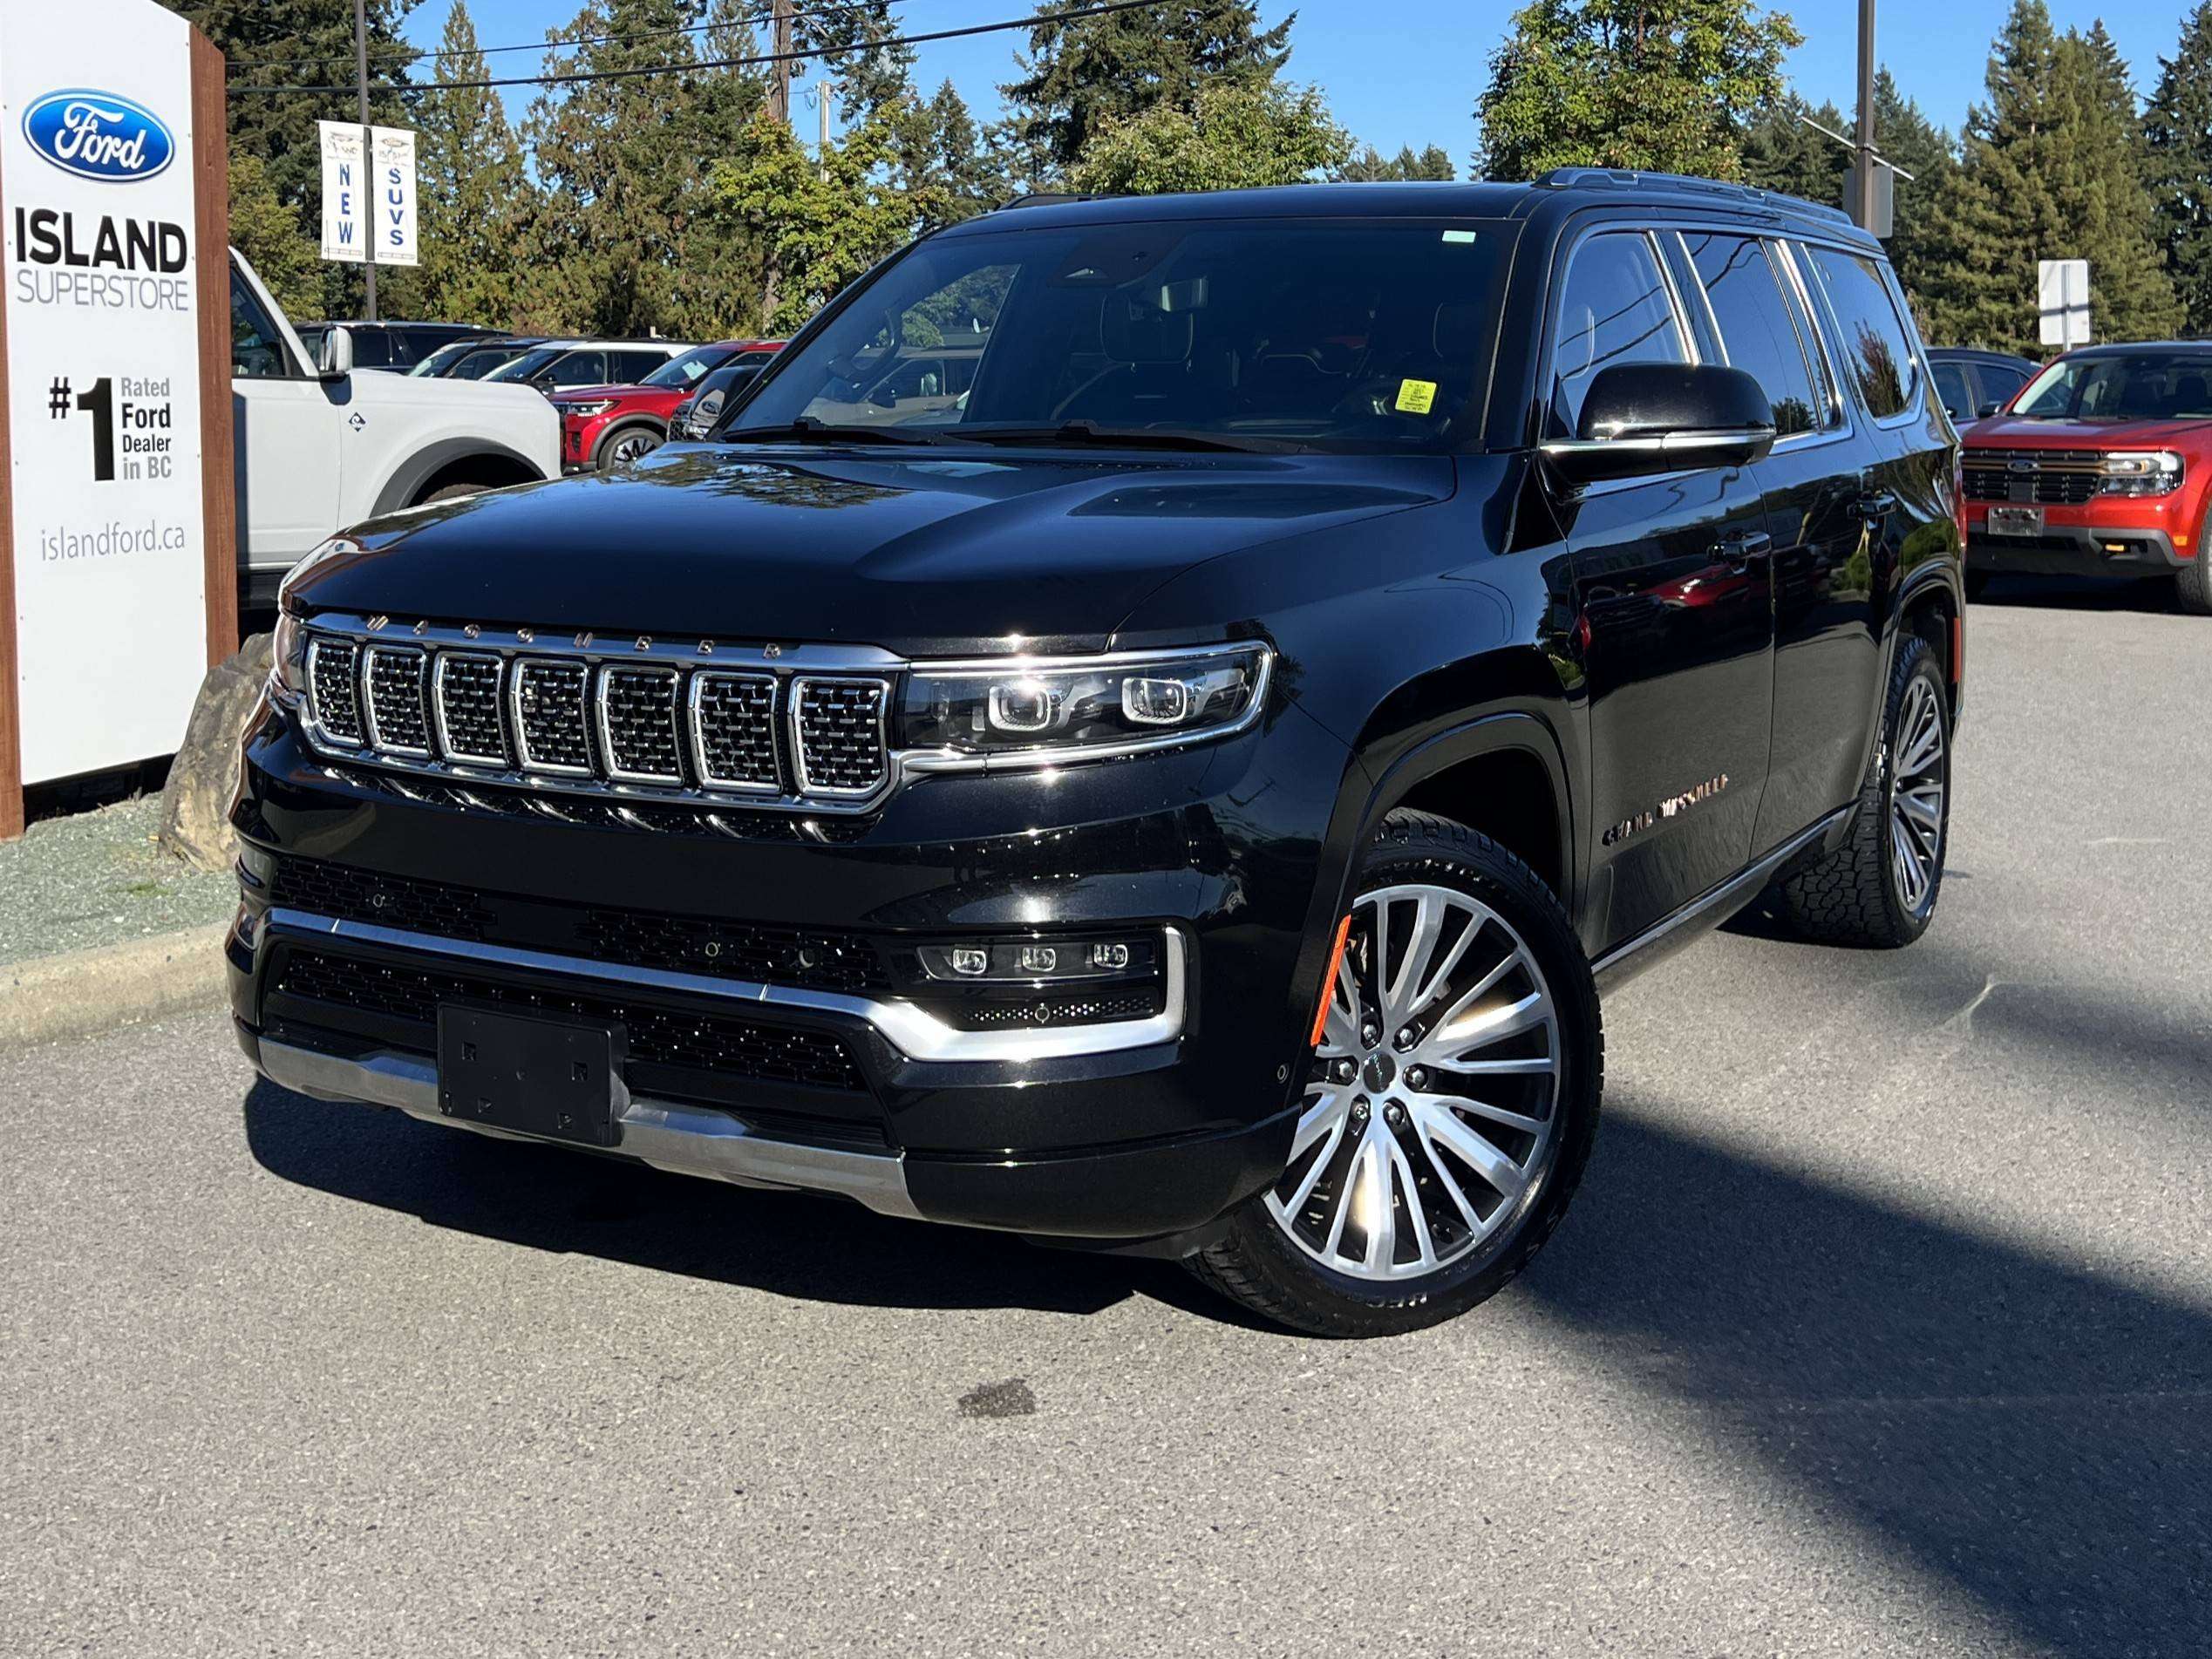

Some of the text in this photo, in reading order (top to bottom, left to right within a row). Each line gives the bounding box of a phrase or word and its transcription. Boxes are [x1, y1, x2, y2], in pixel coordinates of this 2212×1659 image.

[54, 102, 146, 169] Ford
[338, 163, 353, 244] NEW
[388, 167, 404, 246] SUVS
[15, 207, 187, 274] ISLAND
[17, 269, 188, 311] SUPERSTORE
[121, 377, 170, 398] Rated
[49, 377, 115, 481] #1
[121, 403, 171, 429] Ford
[122, 434, 172, 453] Dealer
[123, 455, 172, 480] in BC
[42, 519, 185, 561] islandford.ca
[366, 615, 782, 660] WAGONEER
